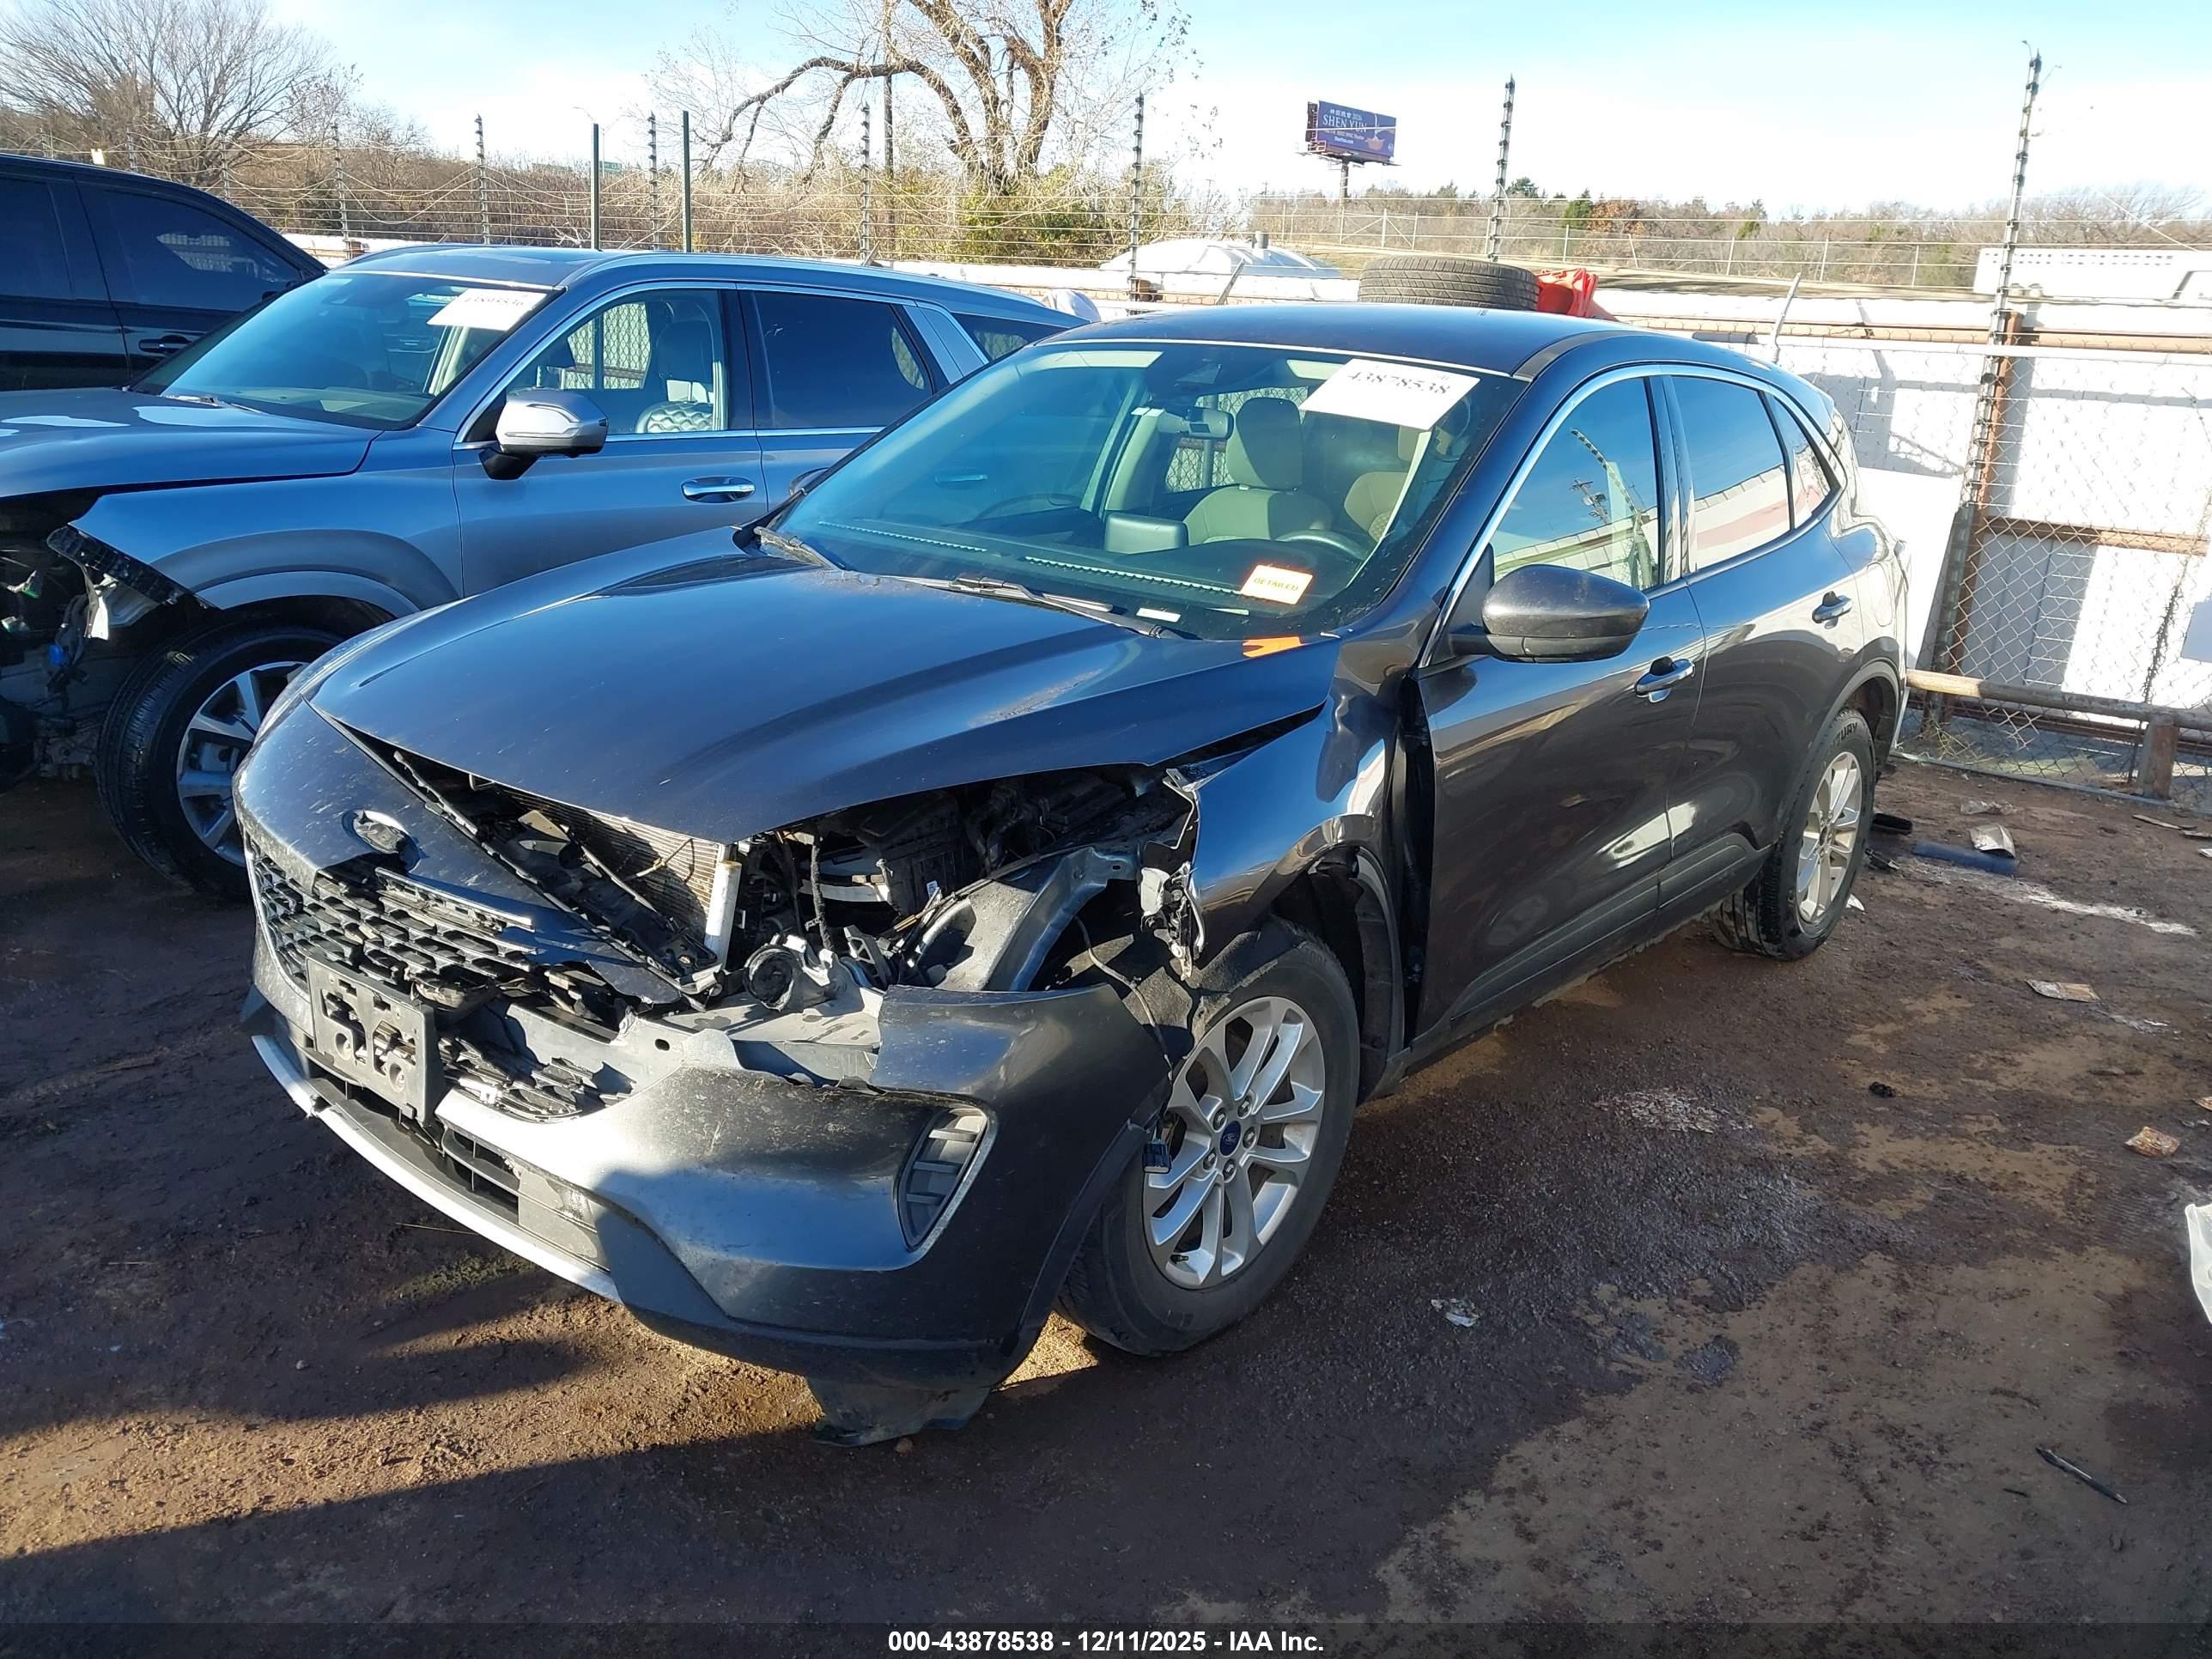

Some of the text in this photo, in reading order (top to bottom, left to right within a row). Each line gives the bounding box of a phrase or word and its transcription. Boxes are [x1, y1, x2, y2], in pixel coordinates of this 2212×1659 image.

[1322, 113, 1347, 129] SHEN
[1348, 120, 1368, 133] YUN
[1347, 371, 1450, 394] 43878538
